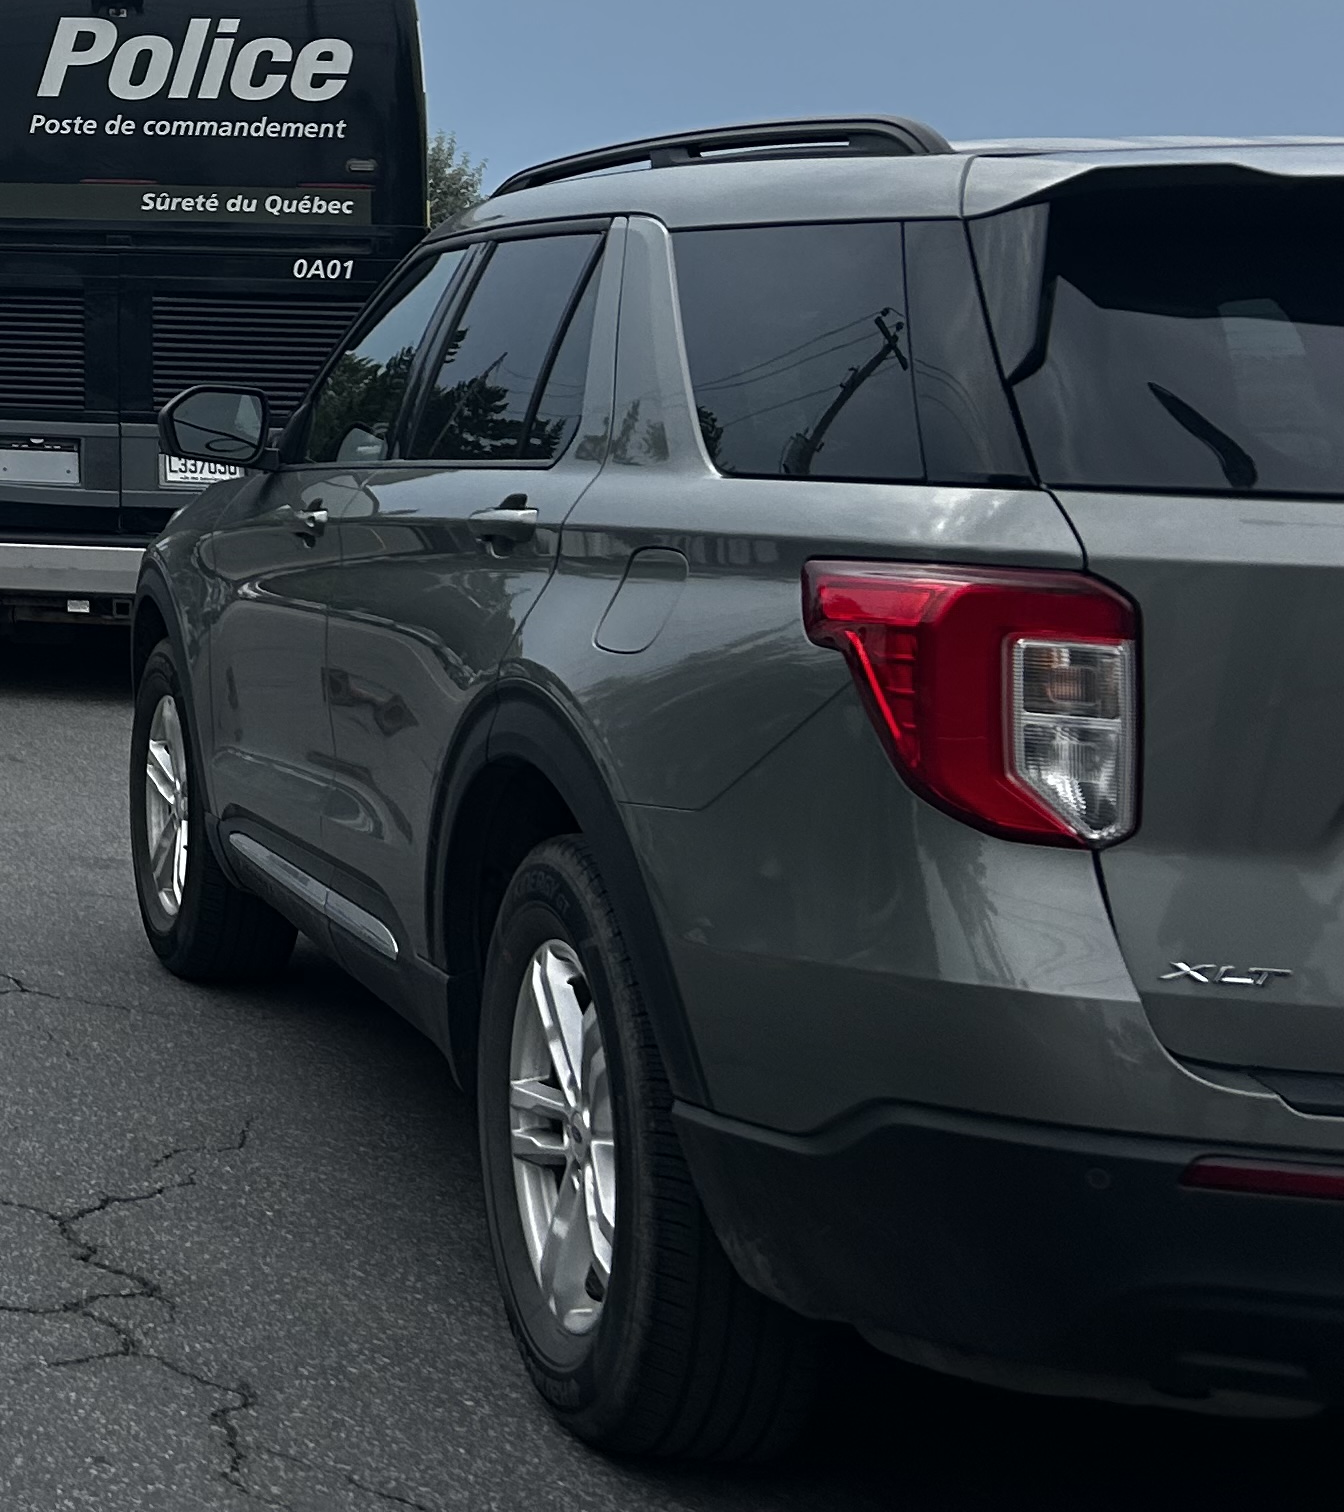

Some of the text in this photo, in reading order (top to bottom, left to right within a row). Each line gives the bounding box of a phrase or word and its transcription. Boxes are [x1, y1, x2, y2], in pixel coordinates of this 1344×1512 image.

[36, 16, 354, 102] Police
[29, 114, 348, 139] Poste de commandement
[141, 192, 355, 216] Sûreté du Québec
[292, 259, 355, 280] 0A01
[1159, 961, 1294, 985] XLT
